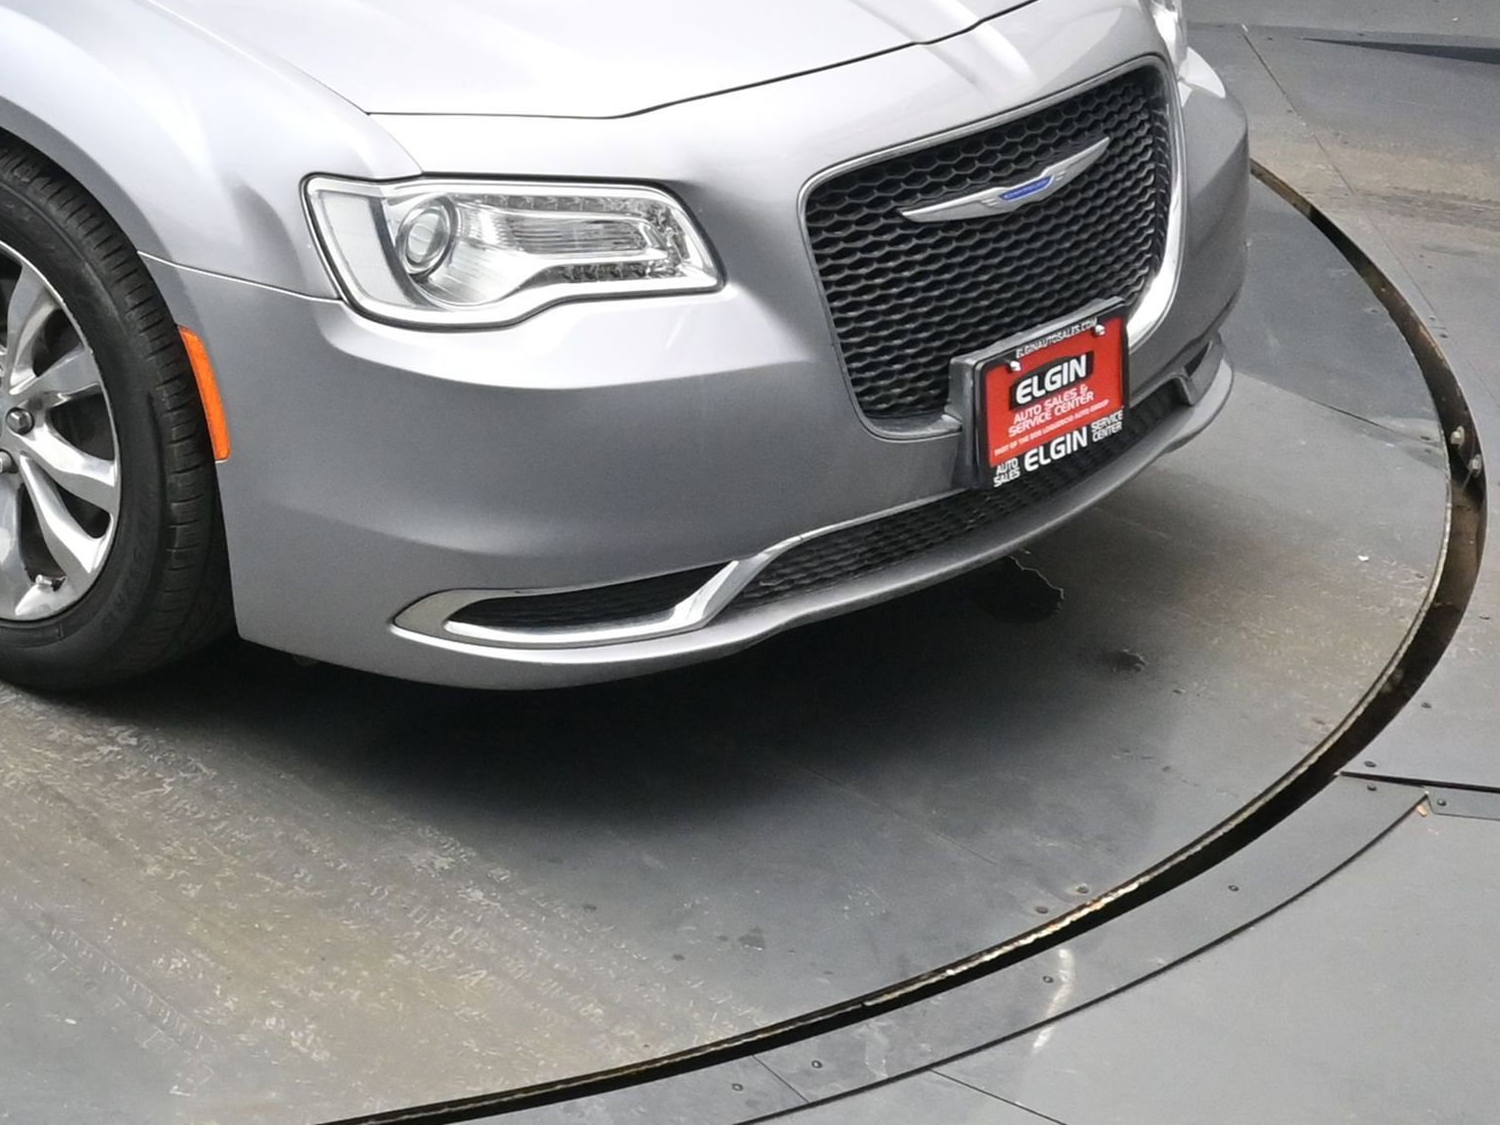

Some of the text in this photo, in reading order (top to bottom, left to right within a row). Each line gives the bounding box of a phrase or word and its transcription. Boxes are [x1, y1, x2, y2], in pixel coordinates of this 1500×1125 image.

[1016, 355, 1087, 405] ELGIN
[1008, 411, 1052, 438] SERVICE
[1054, 391, 1094, 417] CENTER
[1013, 405, 1042, 425] AUTO
[1044, 386, 1078, 408] SALES
[1091, 409, 1123, 432] SERVICE
[1092, 421, 1123, 442] CENTER
[1024, 427, 1087, 472] ELGIN
[993, 469, 1020, 488] SALES
[996, 457, 1018, 475] AUTO
